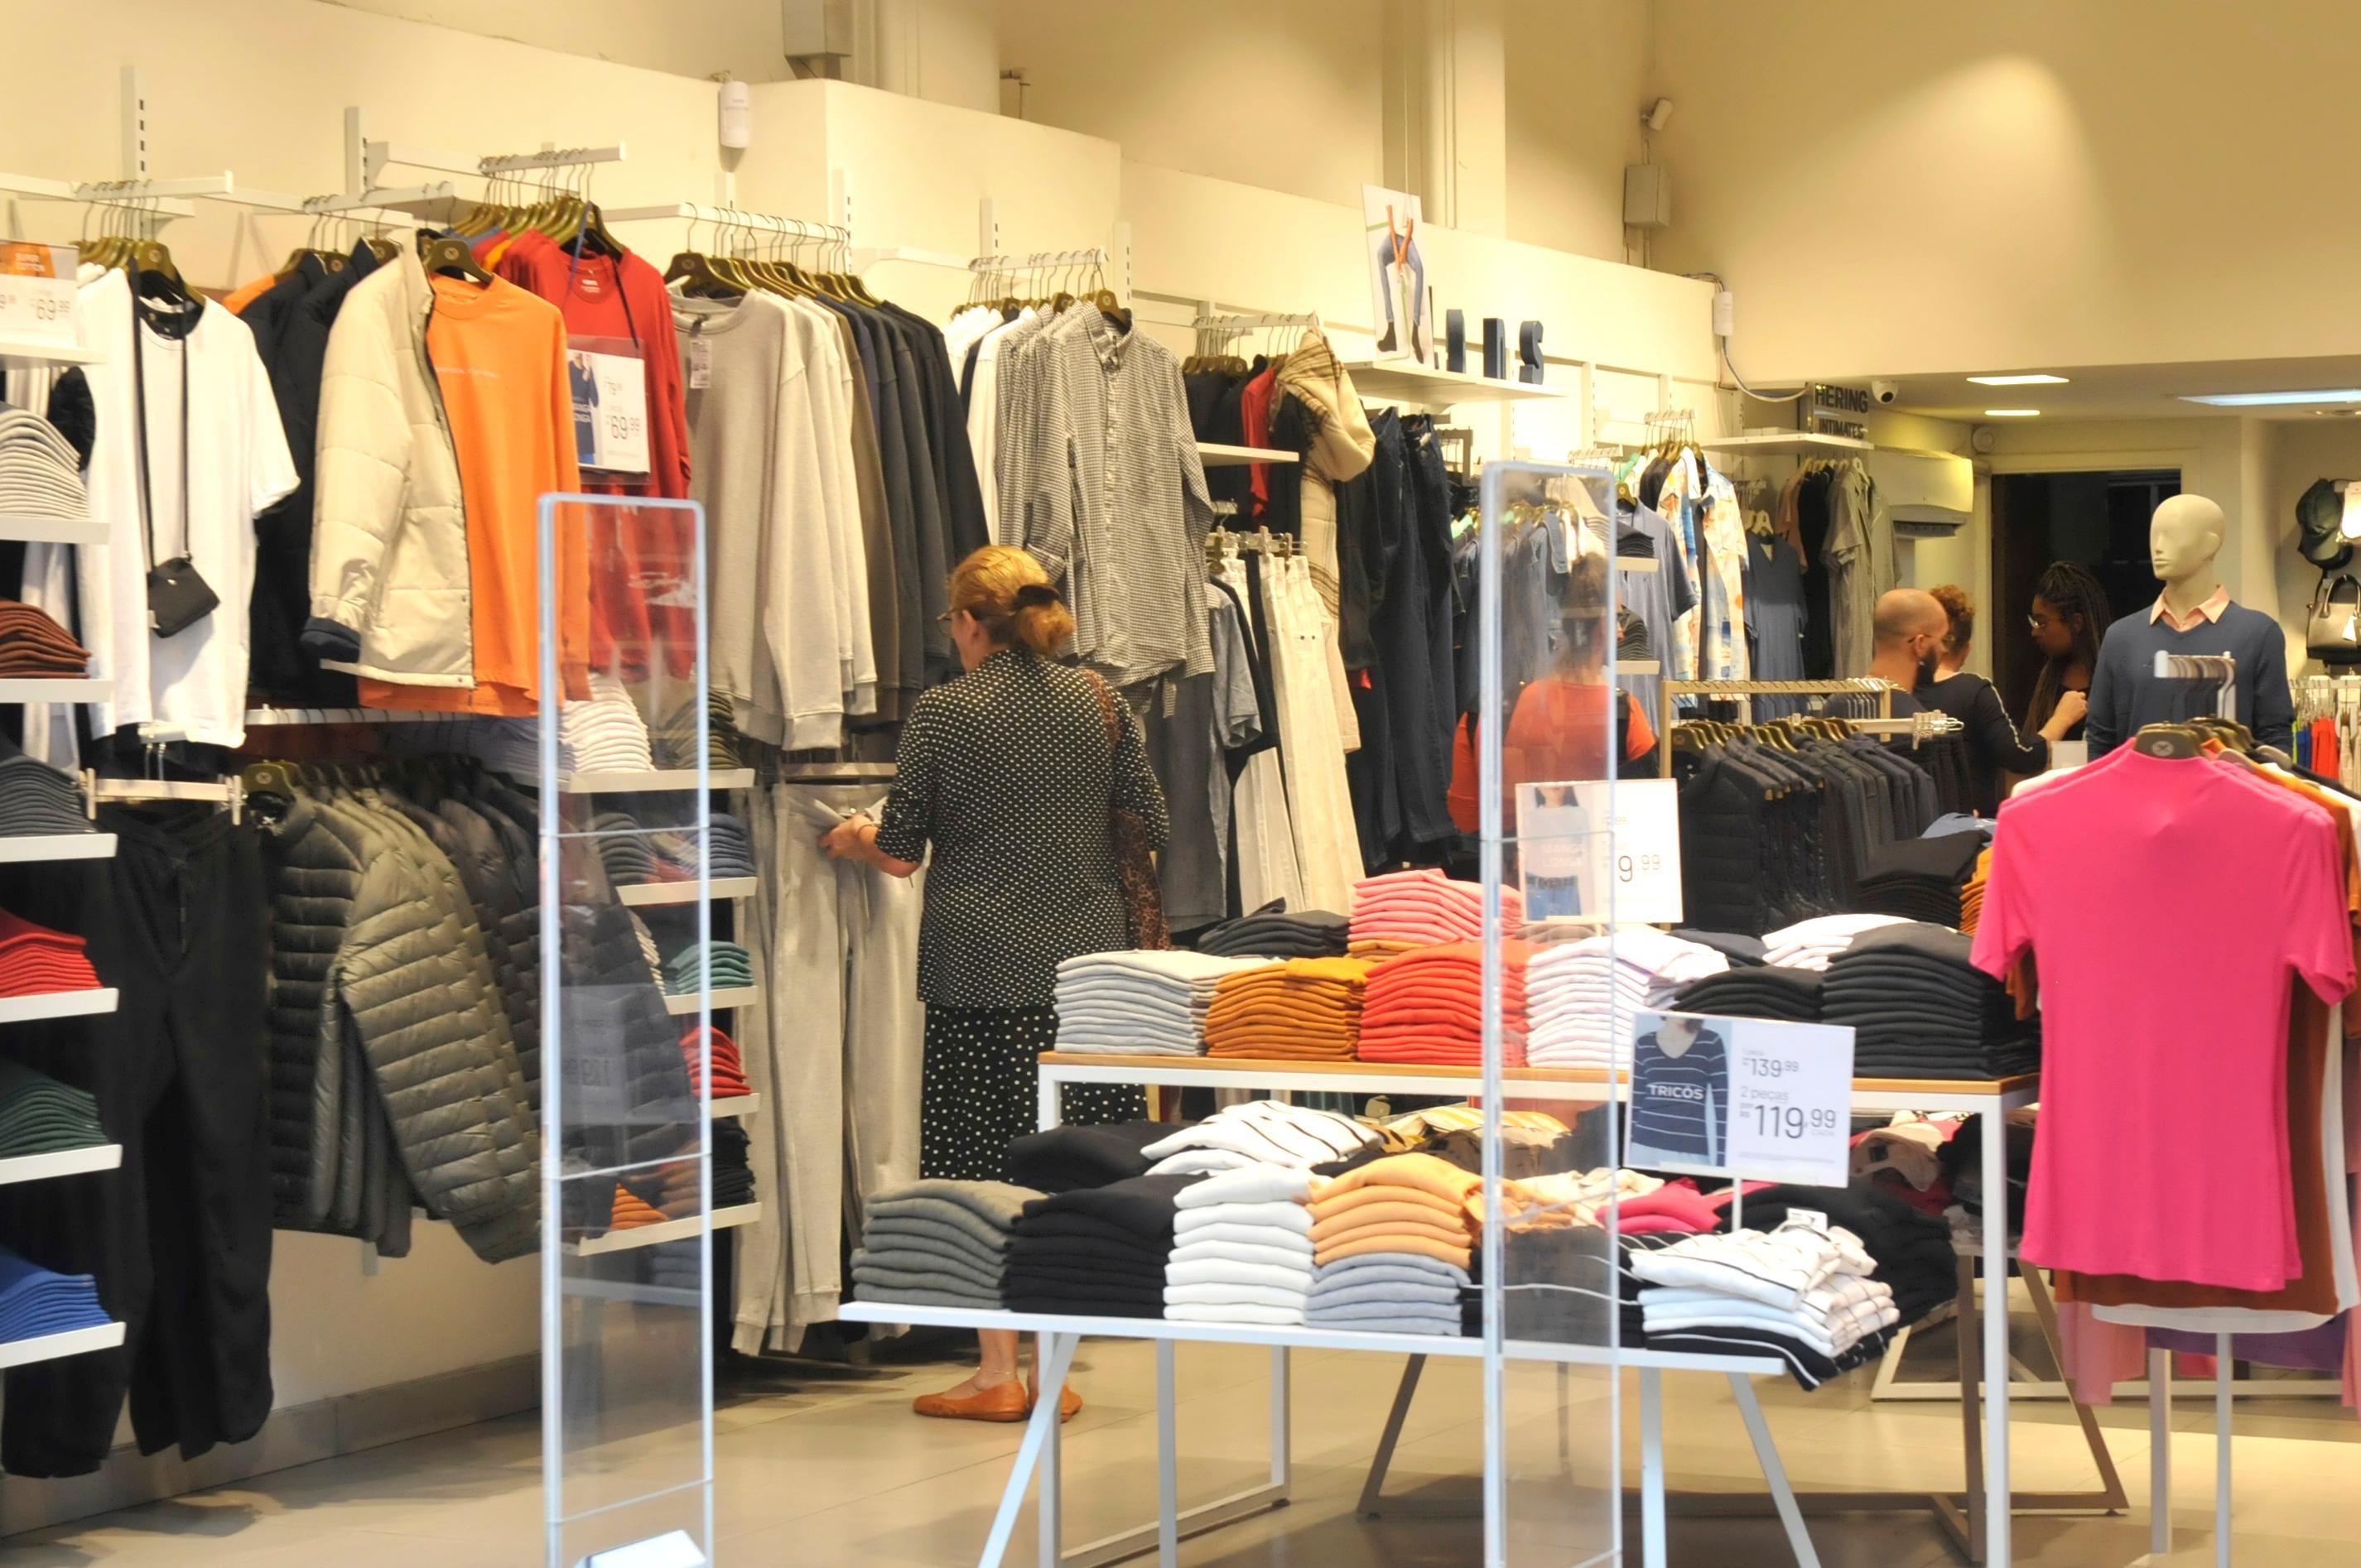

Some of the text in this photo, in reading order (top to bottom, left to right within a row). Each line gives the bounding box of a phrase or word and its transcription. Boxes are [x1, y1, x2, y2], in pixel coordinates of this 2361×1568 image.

[1814, 383, 1868, 414] HERING
[1740, 1085, 1790, 1103] 2 peças
